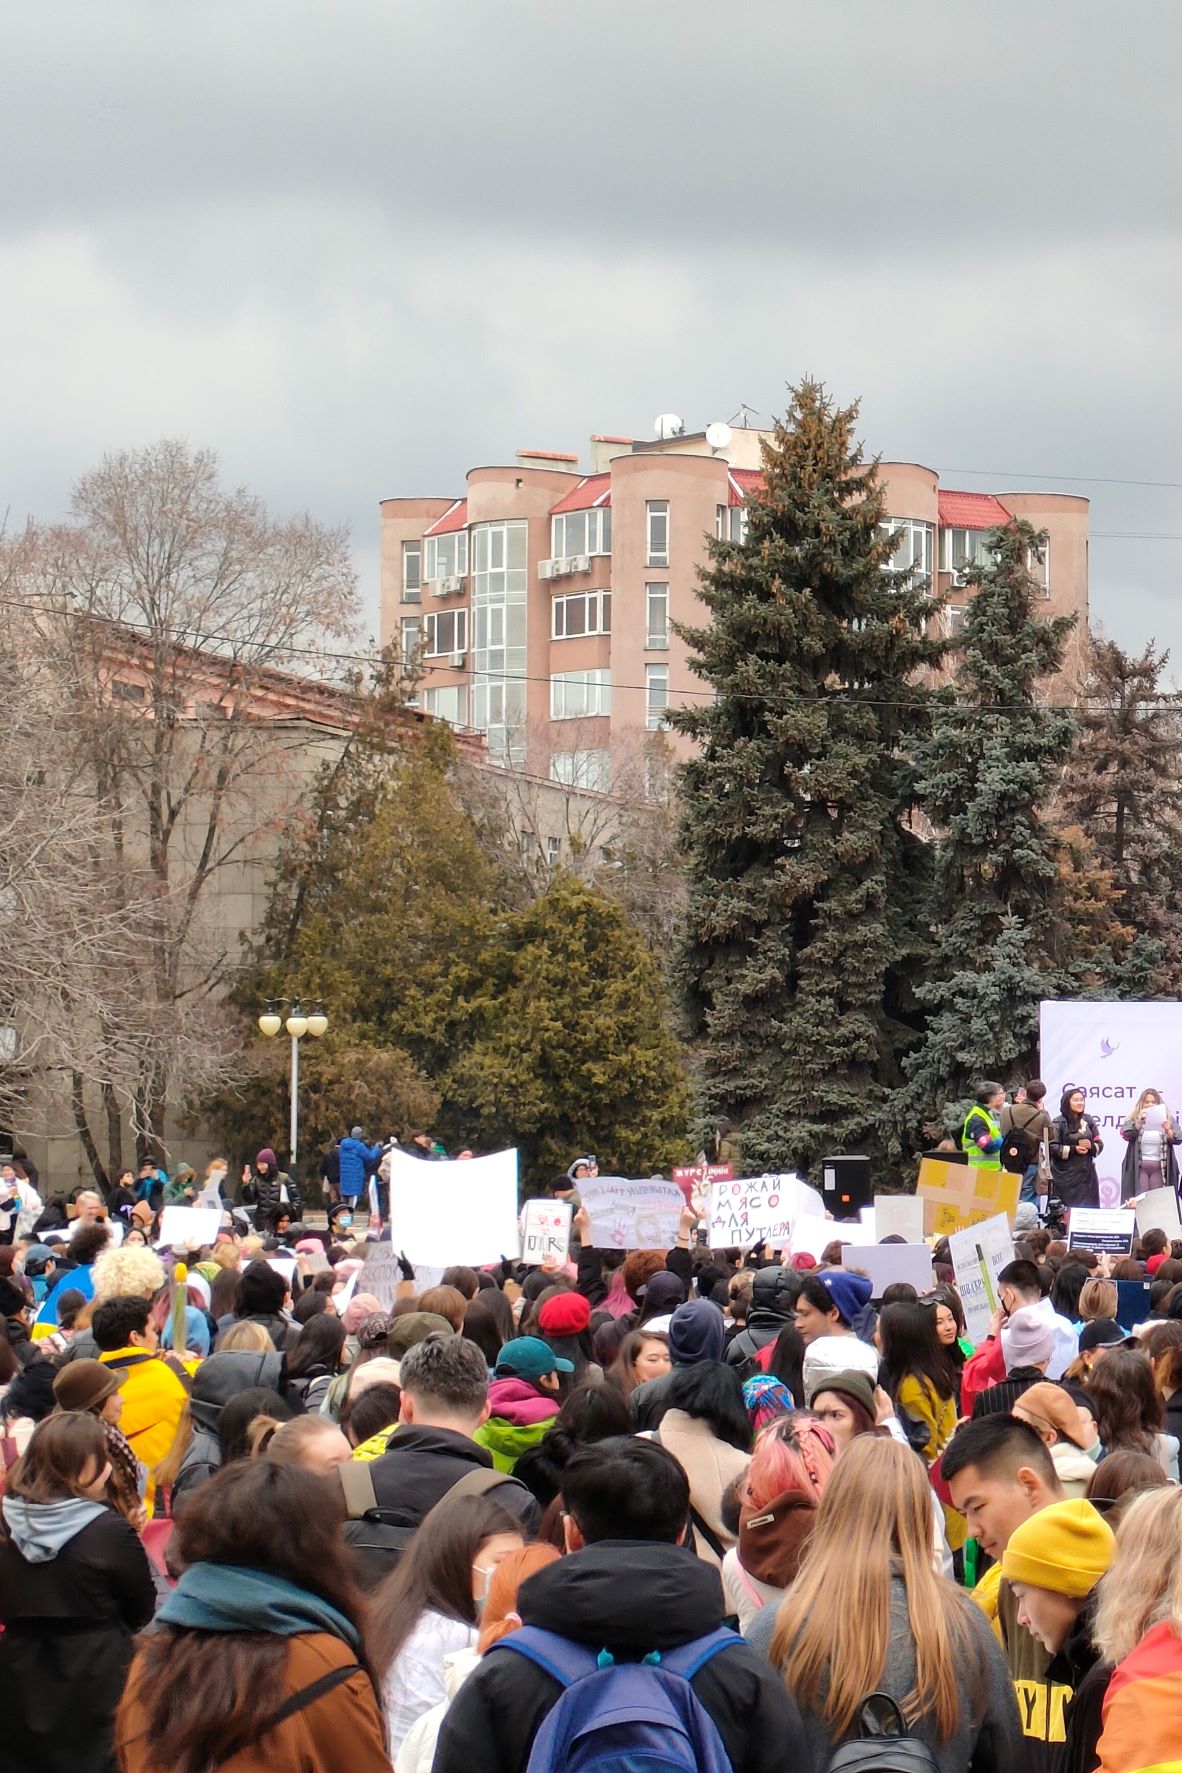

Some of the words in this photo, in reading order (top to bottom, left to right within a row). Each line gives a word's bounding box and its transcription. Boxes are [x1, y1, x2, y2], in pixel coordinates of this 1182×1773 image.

[1062, 1083, 1136, 1098] Саясат
[719, 1178, 781, 1196] РОЖАЙ
[717, 1194, 779, 1211] МЯСО
[711, 1211, 749, 1229] ДЛЯ
[731, 1220, 790, 1245] ПУТЛЕРА
